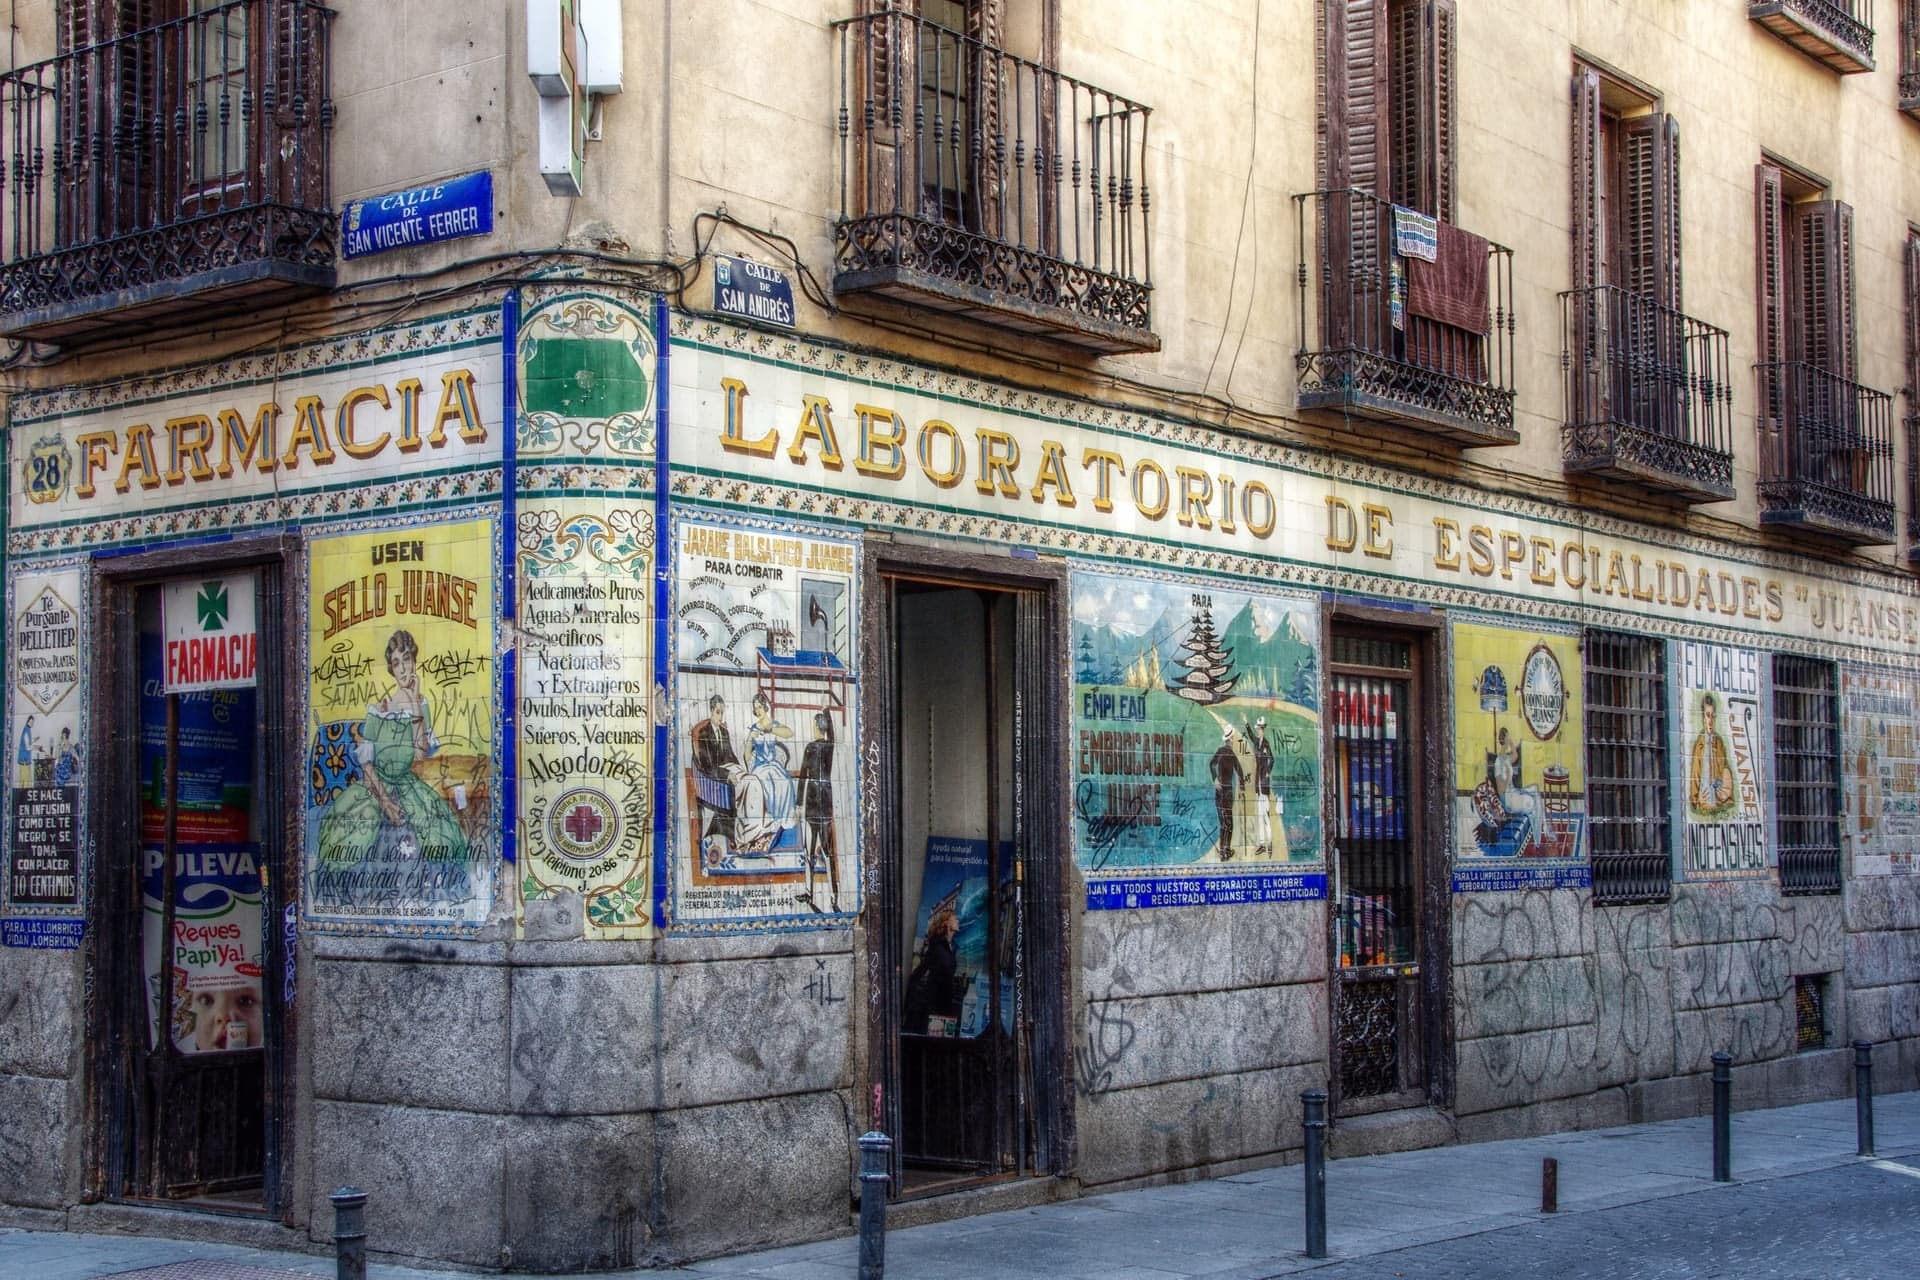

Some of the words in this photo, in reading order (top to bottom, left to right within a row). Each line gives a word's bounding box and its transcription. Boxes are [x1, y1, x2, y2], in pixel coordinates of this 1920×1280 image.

[381, 186, 445, 211] CALLE
[403, 206, 418, 218] DE
[348, 231, 372, 255] SAN
[375, 218, 424, 249] VICENTE
[429, 206, 478, 238] FERRER
[745, 263, 782, 283] CALLE
[760, 282, 771, 293] DE
[721, 288, 745, 313] SAN
[749, 296, 790, 323] ANDRÉS
[75, 368, 488, 500] FARMACIA
[32, 453, 61, 493] 28
[719, 377, 1276, 540] LABORATORIO
[1325, 495, 1394, 560] DE
[1432, 516, 1784, 623] ESPECIALIDADES
[371, 541, 424, 566] USEN
[684, 527, 730, 562] JARABE
[806, 542, 854, 574] JUANSE
[705, 560, 732, 576] PARA
[735, 564, 783, 581] COMBATIR
[610, 580, 645, 601] Puros
[688, 575, 726, 590] BRONQUITIS
[41, 596, 53, 612] Té
[323, 572, 387, 641] SELLO
[395, 570, 477, 630] JUANSE
[678, 600, 705, 618] CATARROS
[1192, 593, 1213, 609] PARA
[25, 610, 70, 628] Purgante
[525, 603, 570, 628] Aguas
[728, 604, 764, 620] COQUELUCHE
[687, 620, 710, 641] GRIPPE
[53, 655, 76, 668] PLANTAS
[538, 651, 621, 672] Nacionales
[1685, 642, 1757, 696] FUMABLES
[552, 673, 640, 700] Extranjeros
[572, 698, 648, 722] Inyectables
[1083, 692, 1146, 722] EMPLEAD
[583, 724, 646, 745] Vacunas
[1079, 730, 1185, 778] EMBROCACION
[528, 746, 634, 788] Algodones
[27, 790, 38, 801] SE
[41, 789, 63, 801] HACE
[19, 804, 30, 815] EN
[19, 817, 43, 829] COMO
[46, 817, 56, 828] EL
[529, 795, 548, 857] Gasas
[18, 831, 46, 842] NEGRO
[59, 831, 71, 842] SE
[1687, 823, 1764, 871] INOFENSIVOS
[31, 845, 57, 857] TOMA
[17, 859, 35, 870] CON
[36, 859, 69, 870] PLACER
[144, 850, 257, 877] PULEVA
[1459, 880, 1492, 891] PERBORATO
[1470, 872, 1479, 880] LA
[1480, 871, 1503, 880] LIMPIEZA
[1504, 870, 1513, 879] DE
[14, 875, 26, 896] 10
[30, 875, 76, 897] CENTIMOS
[1111, 885, 1122, 895] EN
[1124, 883, 1152, 894] TODOS
[1156, 881, 1201, 893] NUESTROS
[1204, 880, 1258, 892] PREPARADOS
[1263, 880, 1272, 889] EL
[1273, 878, 1304, 889] NOMBRE
[1151, 893, 1206, 905] REGISTRADO
[1252, 890, 1263, 900] DE
[1265, 888, 1320, 899] AUTENTICIDAD
[410, 908, 435, 917] SANIDAD
[685, 900, 712, 910] GENERAL
[713, 900, 721, 909] DE
[4, 921, 25, 933] PARA
[28, 922, 41, 933] LAS
[43, 922, 82, 935] LOMBRICES
[174, 920, 241, 946] Peques
[7, 934, 29, 945] PIDAN
